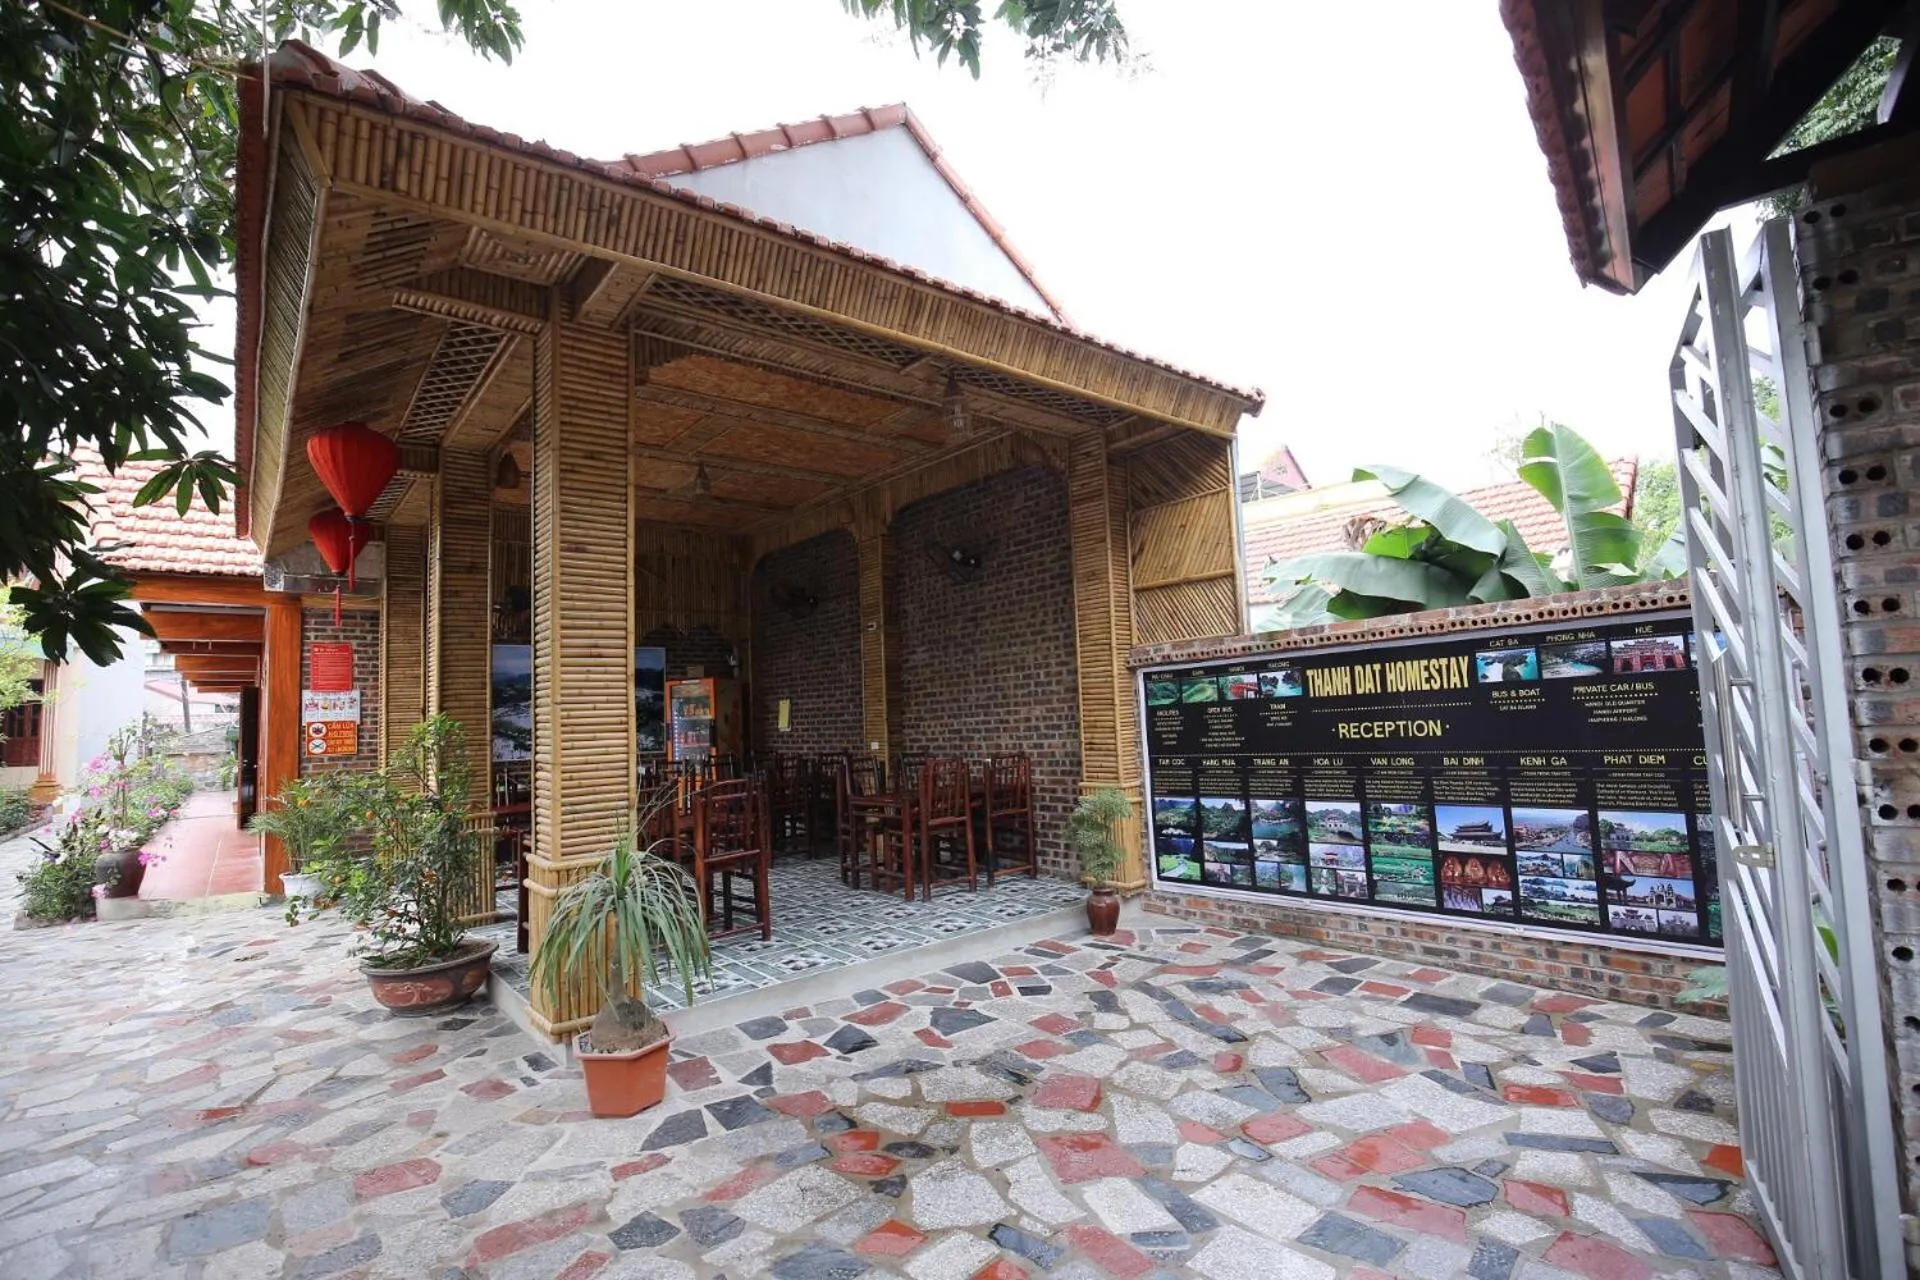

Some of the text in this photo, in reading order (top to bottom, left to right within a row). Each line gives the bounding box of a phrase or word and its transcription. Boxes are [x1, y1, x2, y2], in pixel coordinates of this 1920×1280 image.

[1306, 655, 1469, 698] THANH DAT HOMESTAY
[1492, 690, 1508, 698] BUS
[1519, 688, 1540, 697] BOAT
[1338, 719, 1442, 739] RECEPTION
[1313, 758, 1344, 766] HOA LU
[1370, 757, 1416, 766] VAN LONG
[1443, 757, 1484, 766] BAI DINH
[1520, 756, 1568, 766] KENH GA
[1604, 755, 1666, 764] PHAT DIEM
[1693, 755, 1708, 766] CU
